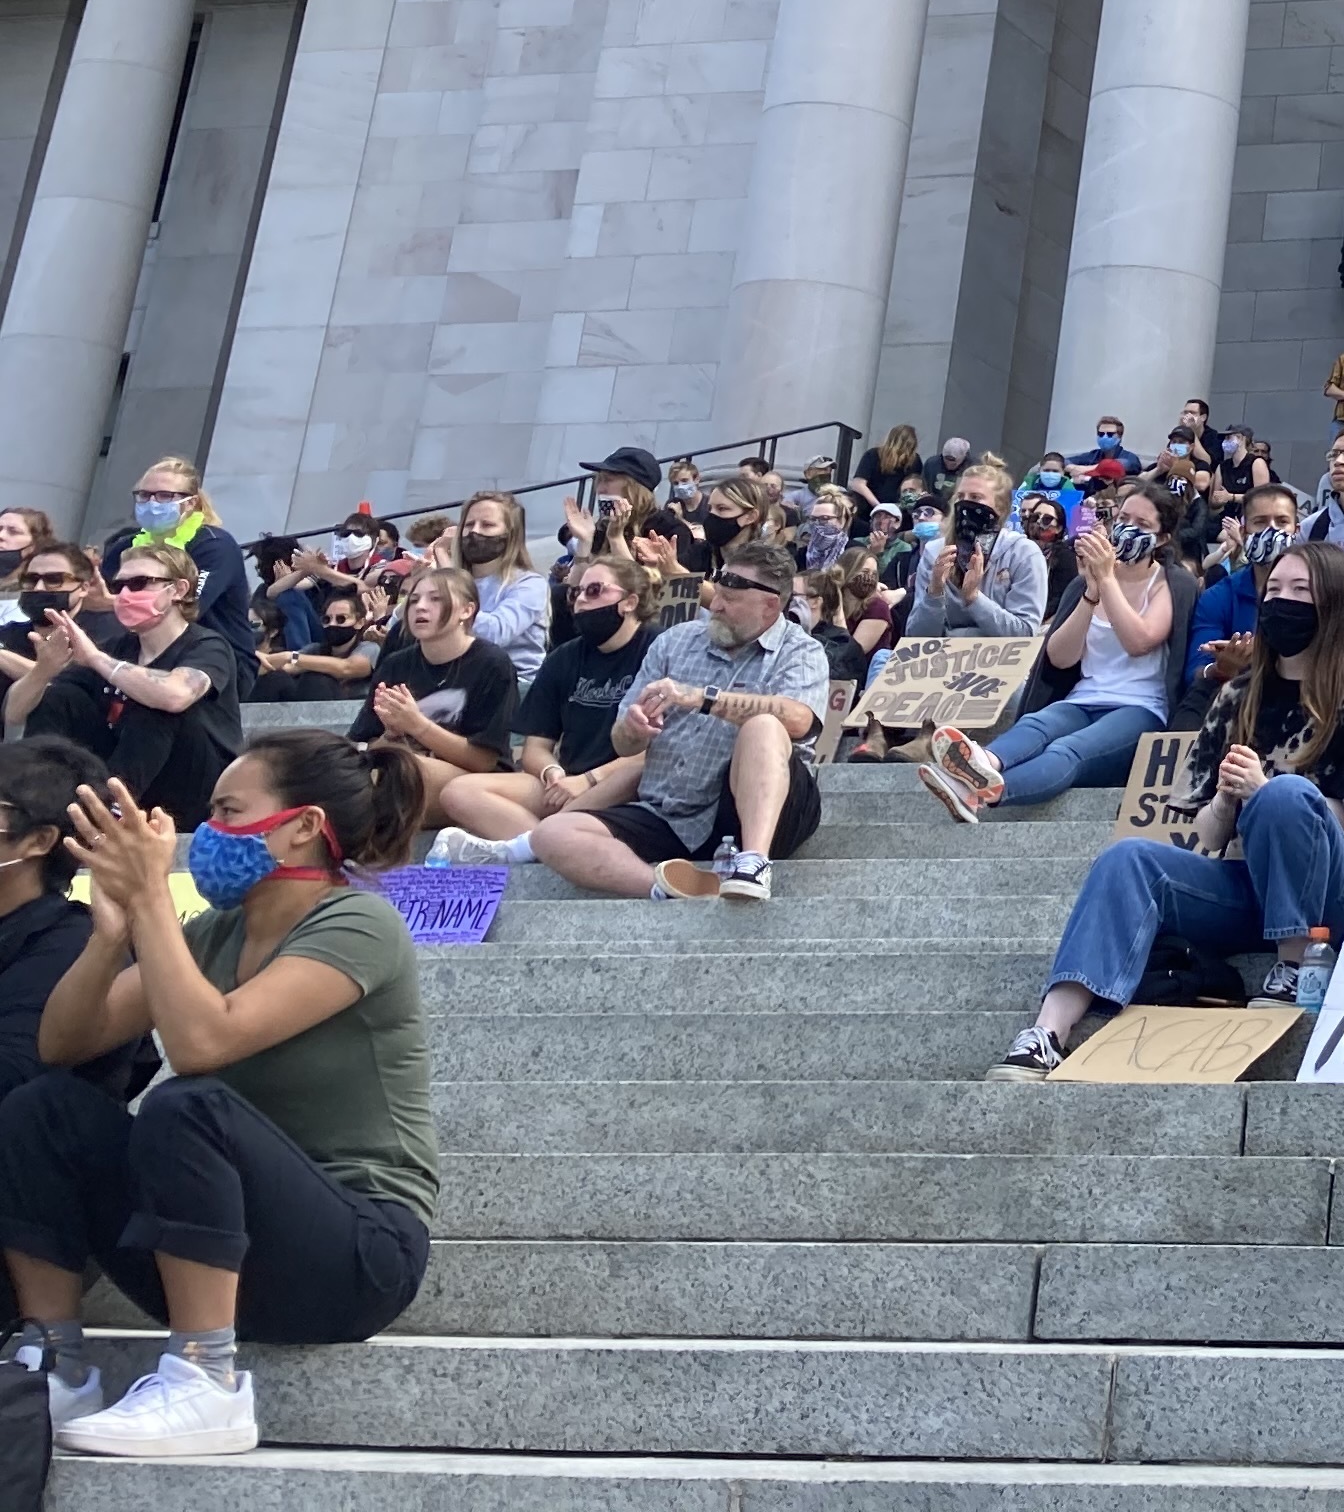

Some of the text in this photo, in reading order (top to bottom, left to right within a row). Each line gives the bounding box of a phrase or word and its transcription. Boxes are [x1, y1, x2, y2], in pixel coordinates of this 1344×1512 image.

[669, 576, 704, 599] THE
[884, 641, 1031, 686] JUSTICE
[896, 639, 943, 662] NO
[945, 671, 1001, 698] NO
[1081, 1015, 1273, 1074] ACAB
